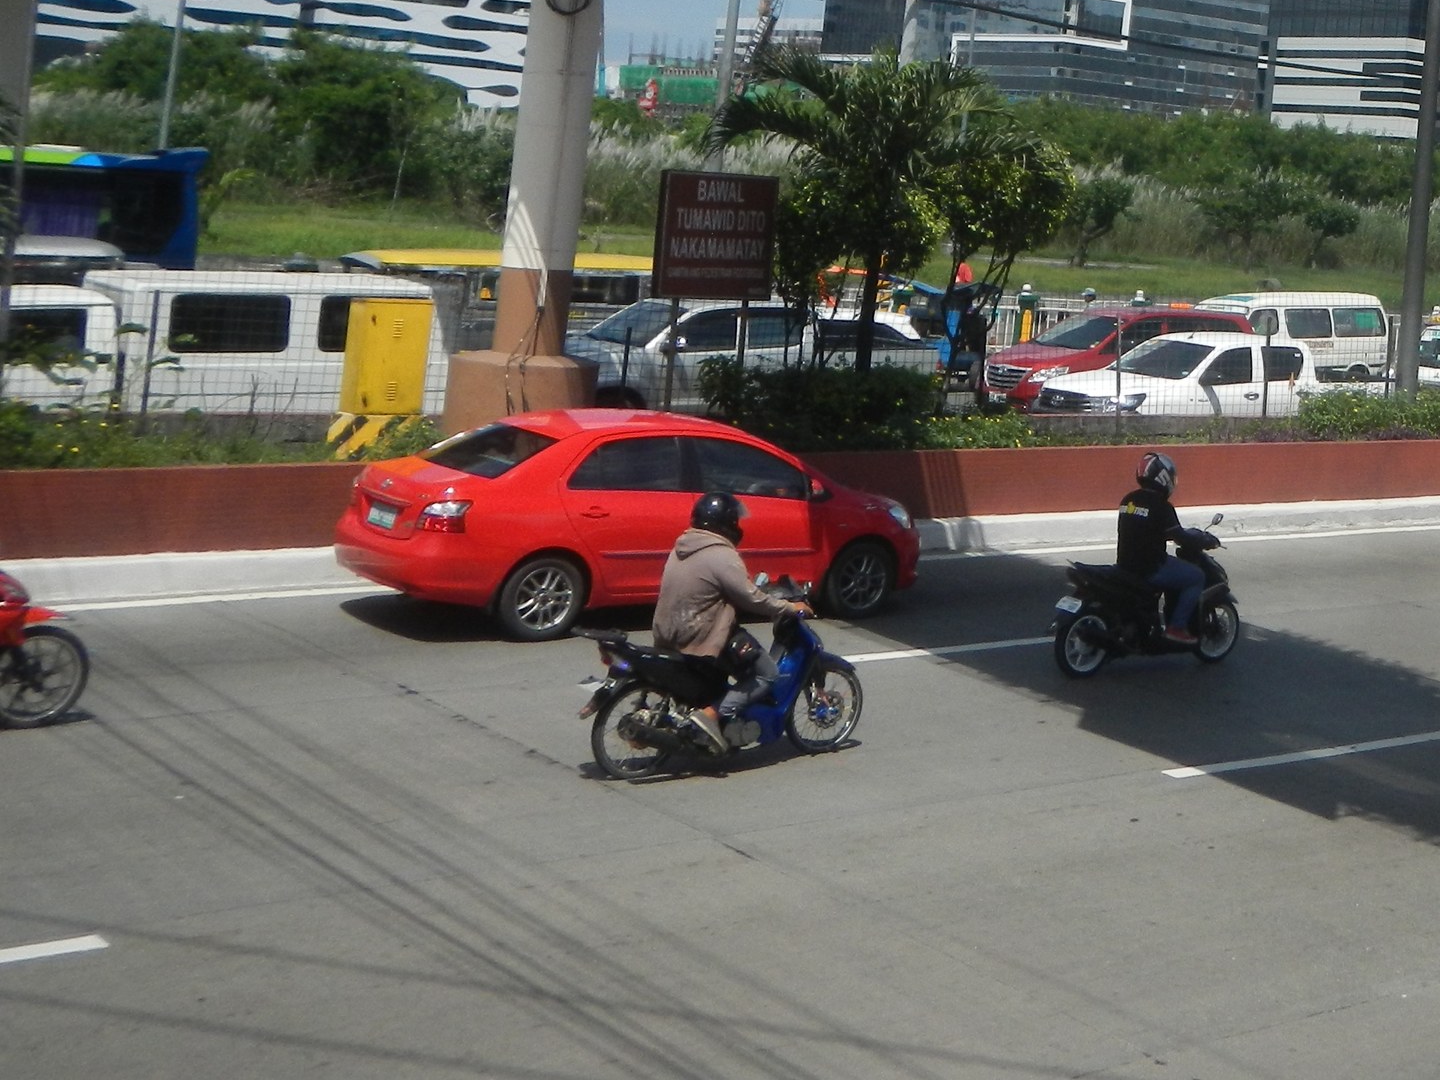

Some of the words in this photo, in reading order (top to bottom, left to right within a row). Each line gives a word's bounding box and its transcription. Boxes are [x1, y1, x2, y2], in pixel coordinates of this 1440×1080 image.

[697, 180, 745, 202] BAWAL
[677, 208, 735, 231] TUMAWID
[737, 210, 765, 232] DITO
[670, 237, 764, 259] NAKAMAMATAY
